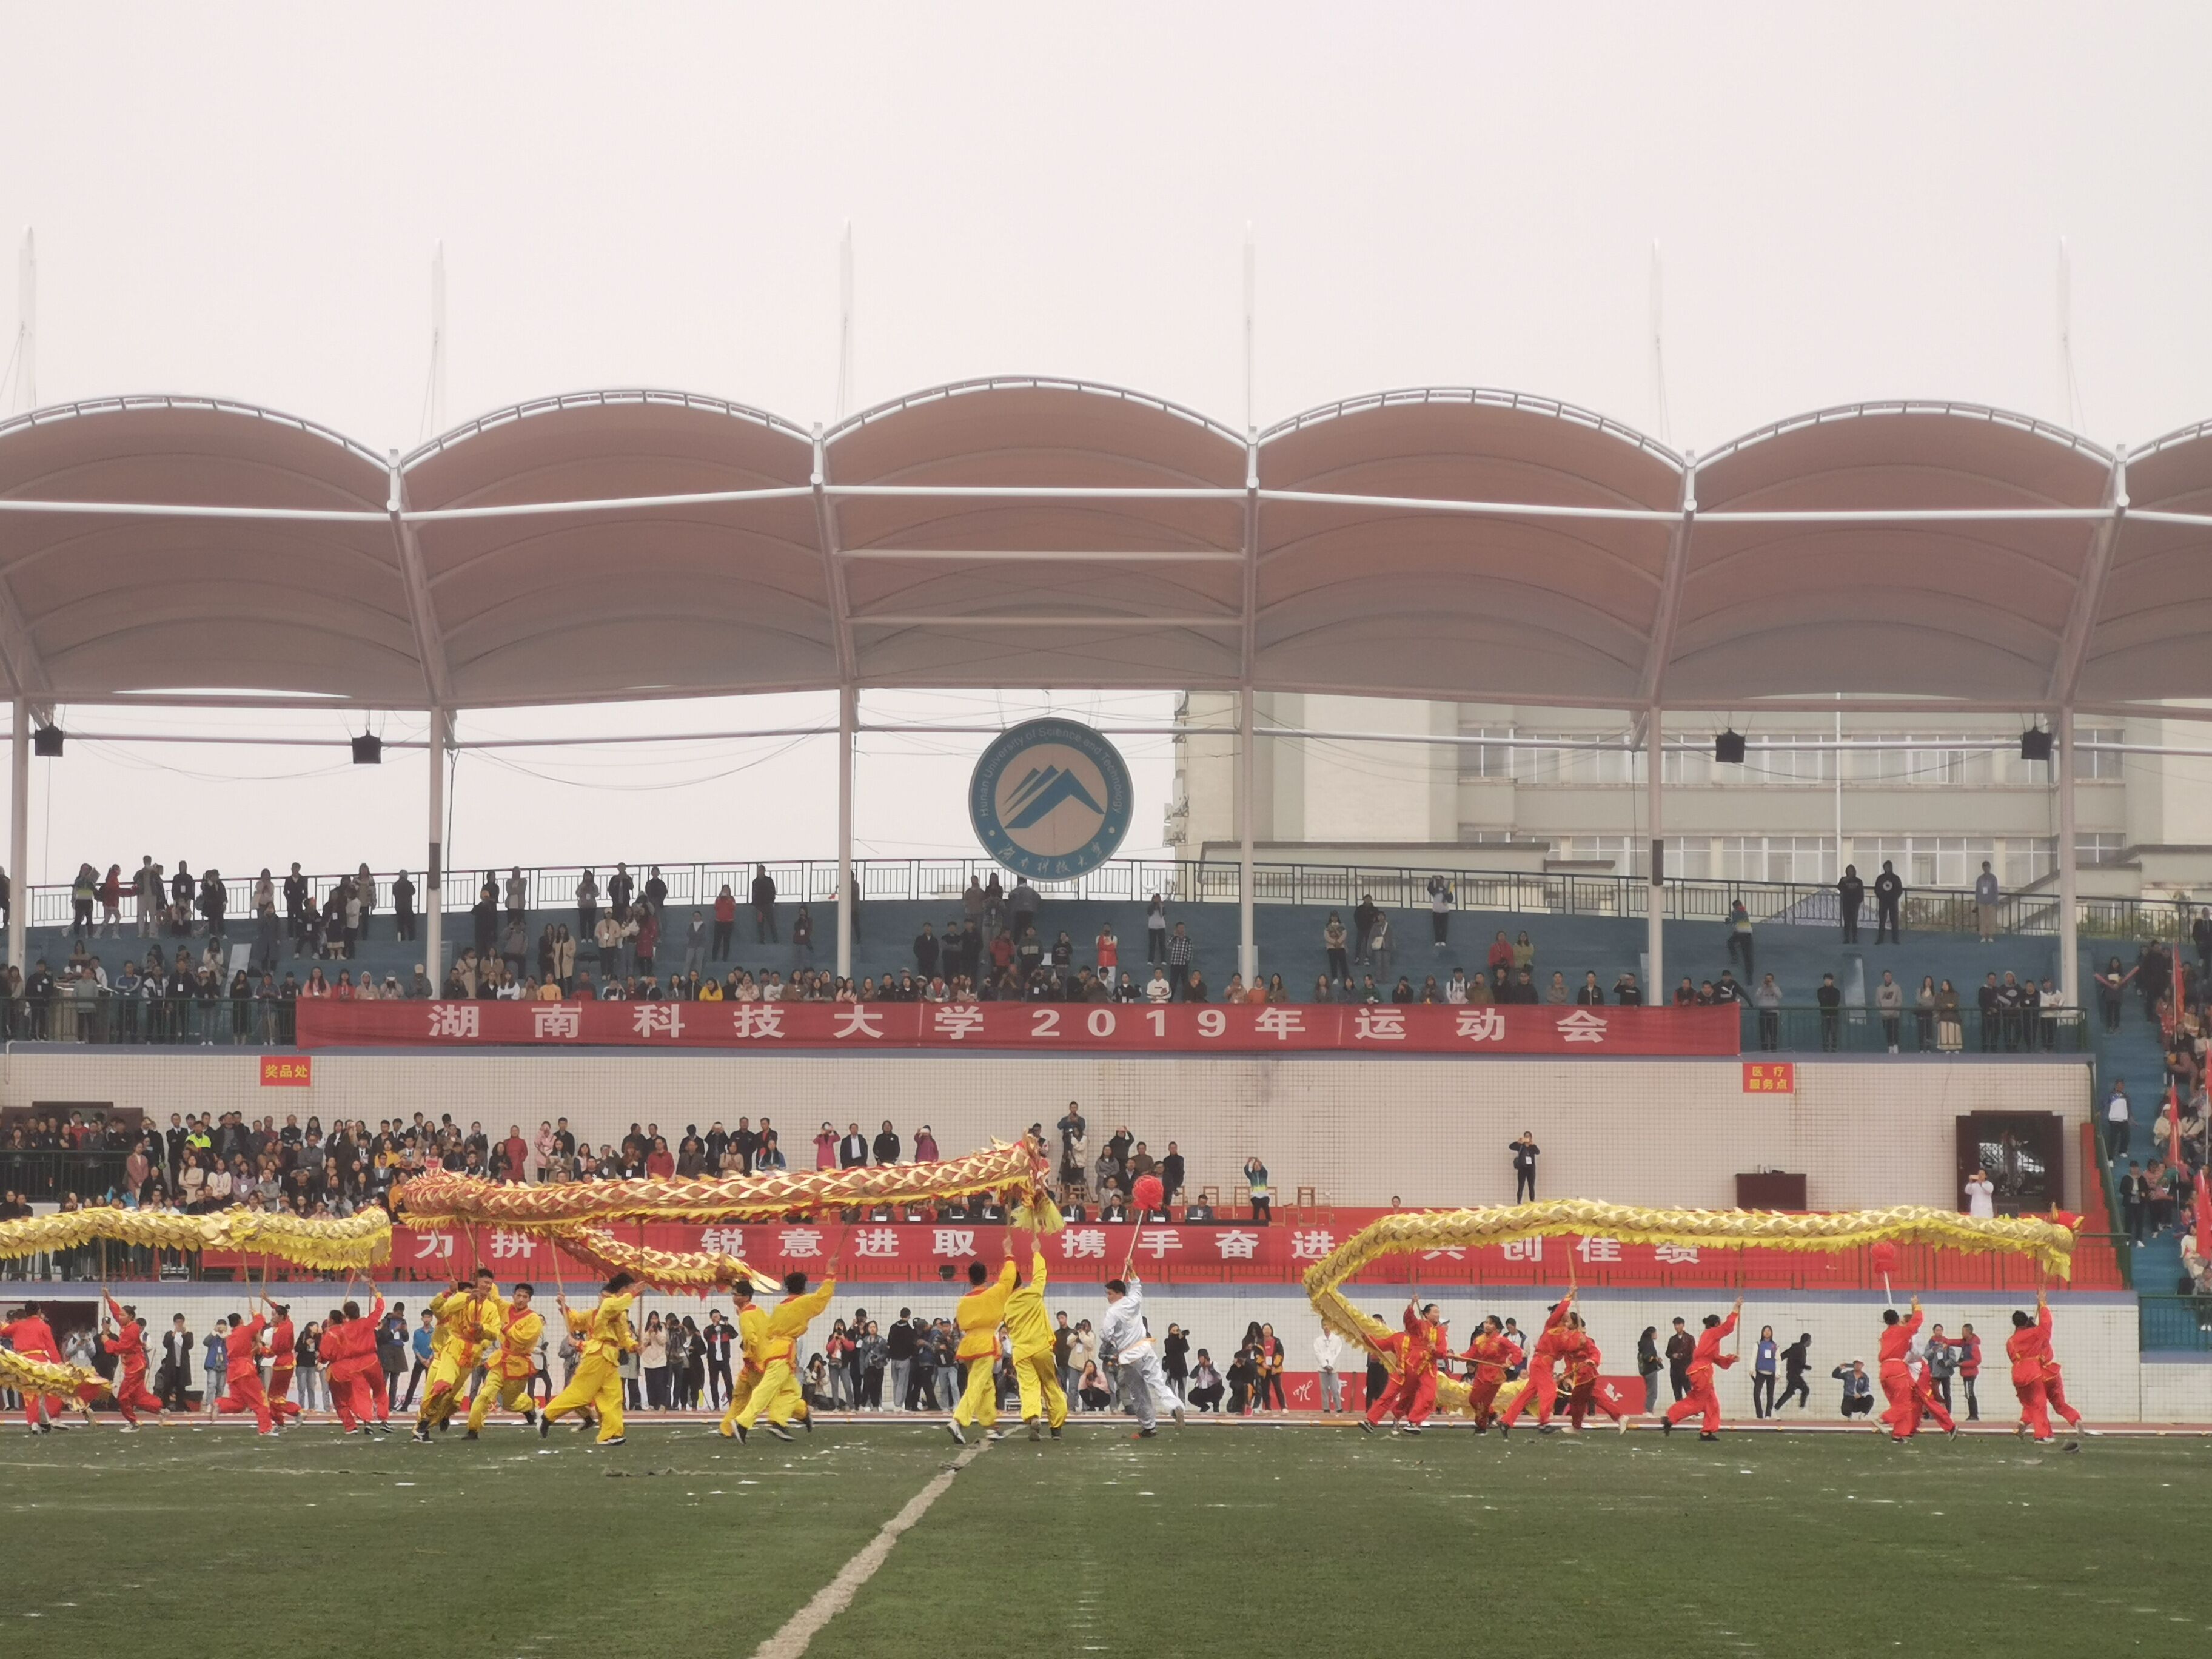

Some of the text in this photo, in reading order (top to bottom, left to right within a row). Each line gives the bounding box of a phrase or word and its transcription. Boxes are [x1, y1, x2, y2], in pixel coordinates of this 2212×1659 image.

[979, 727, 1124, 817] Hunan University of Science and Technology
[428, 1004, 1609, 1042] 湖南科技大学2019年运动会
[265, 1064, 308, 1078] 奖品处
[1752, 1065, 1785, 1077] 医疗
[1749, 1079, 1787, 1090] 服务点
